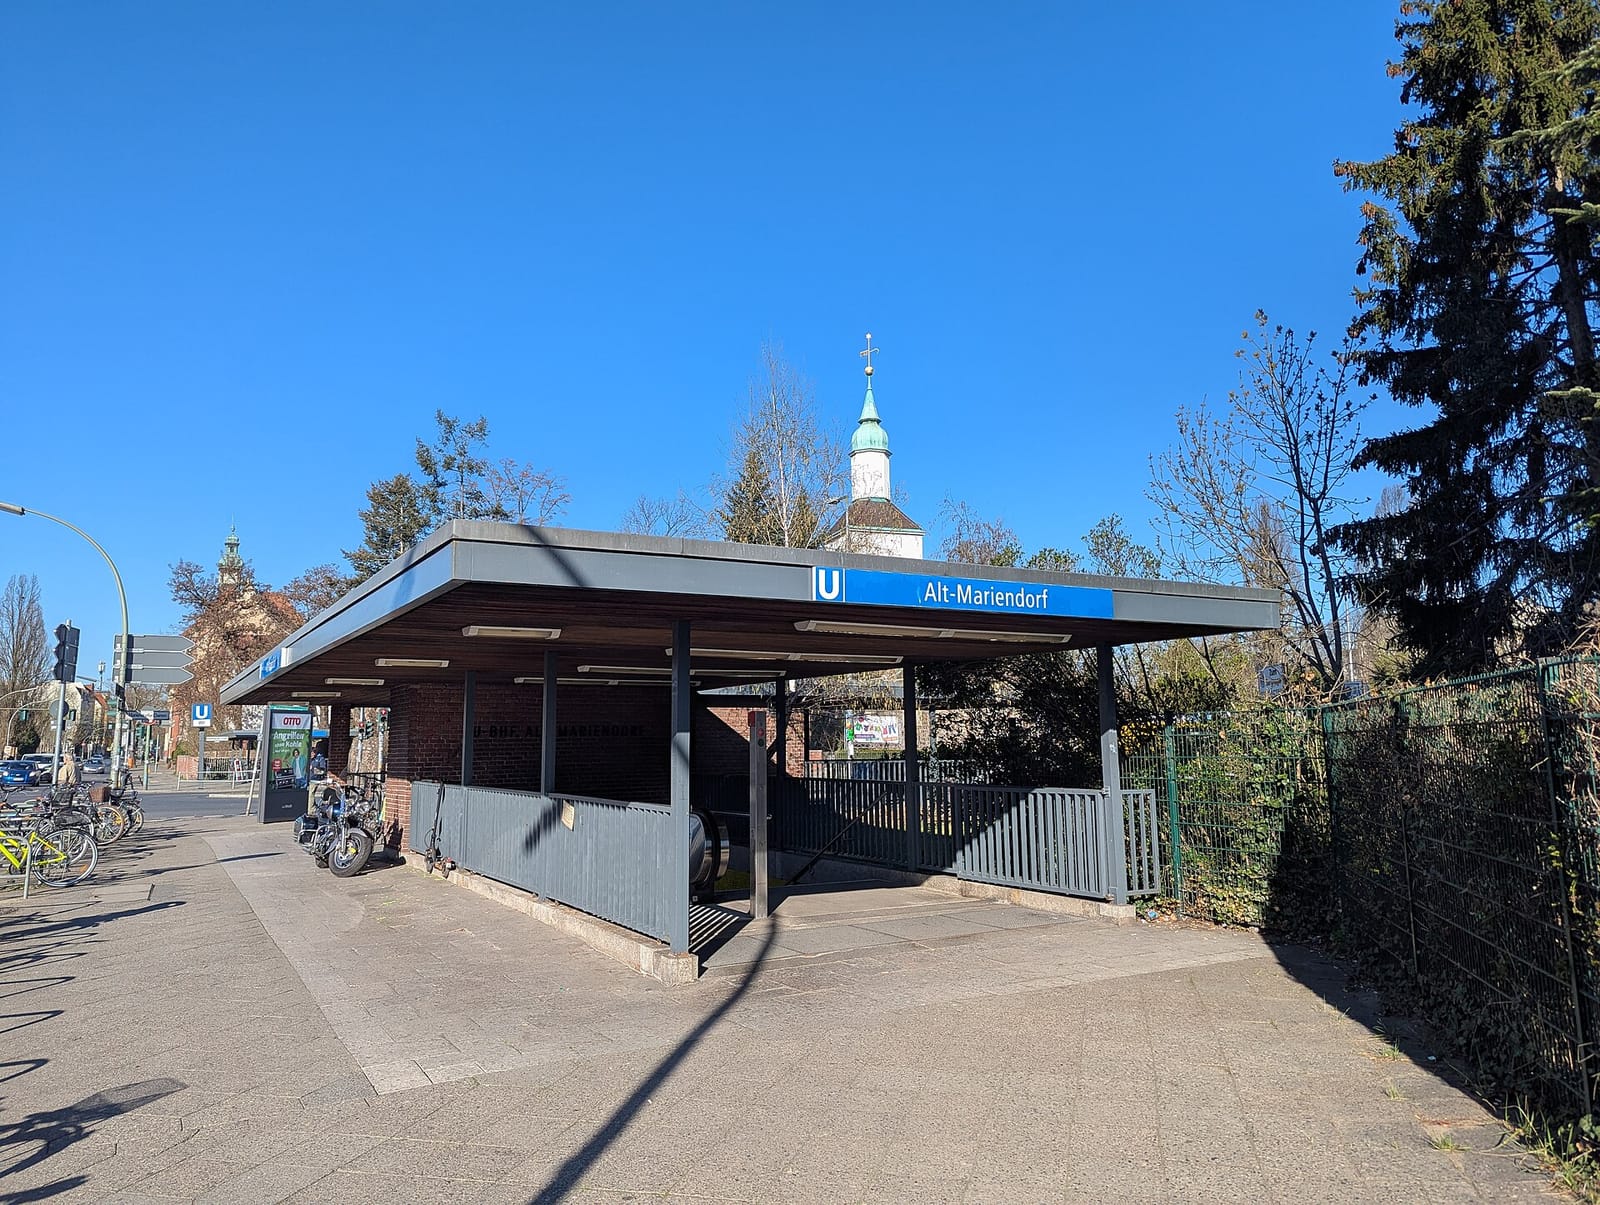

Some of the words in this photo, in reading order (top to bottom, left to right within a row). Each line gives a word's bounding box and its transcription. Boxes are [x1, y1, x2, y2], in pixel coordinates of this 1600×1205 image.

[818, 570, 840, 600] U
[924, 581, 1049, 609] Alt-Mariendorf
[195, 705, 209, 719] U
[283, 717, 301, 725] OTTO
